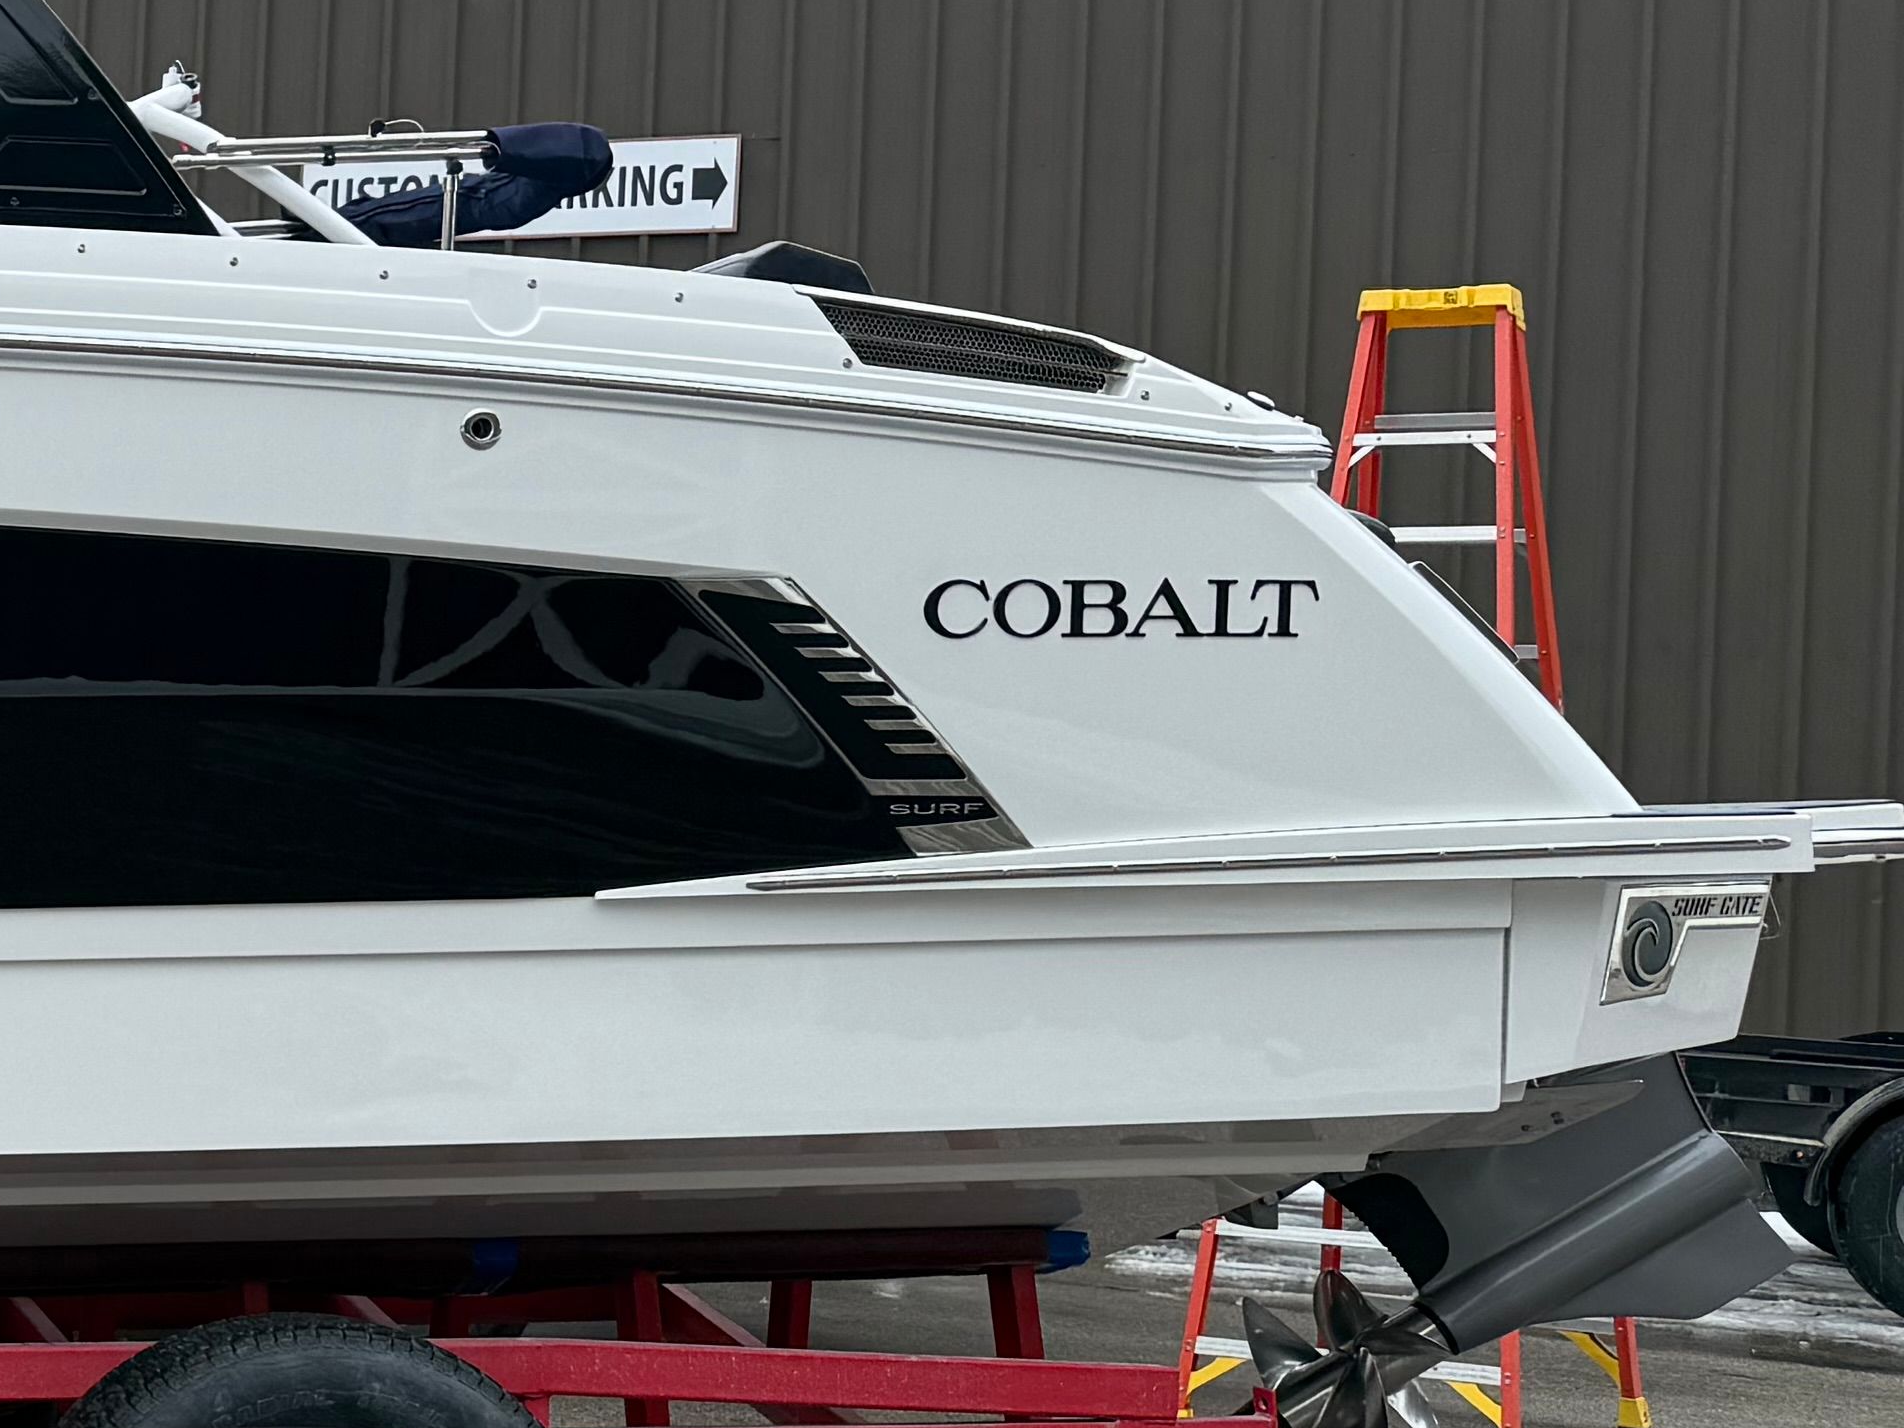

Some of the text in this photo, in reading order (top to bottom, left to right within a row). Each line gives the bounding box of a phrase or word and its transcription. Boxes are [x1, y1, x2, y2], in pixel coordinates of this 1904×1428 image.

[555, 163, 684, 210] KING
[923, 577, 1320, 640] COBALT
[889, 802, 985, 816] SURF
[1672, 895, 1763, 917] SURF GATE
